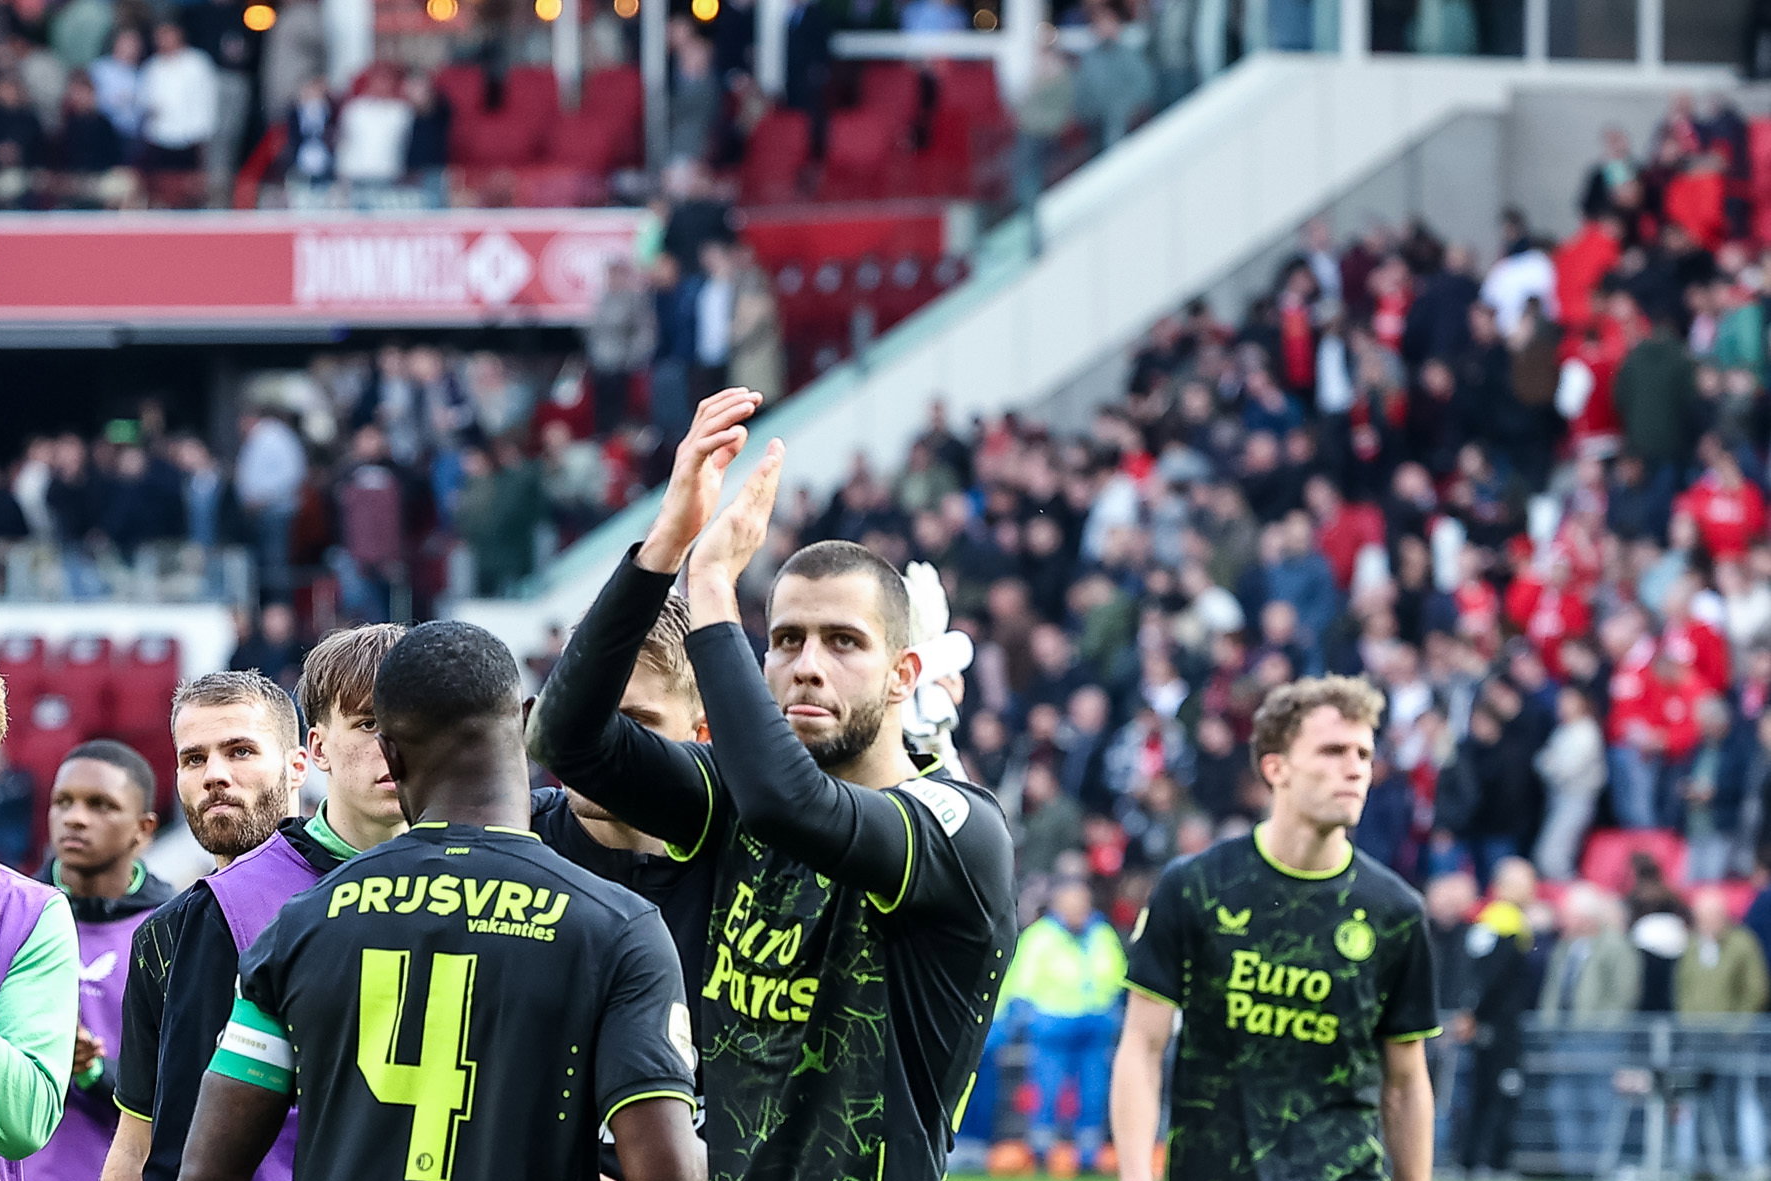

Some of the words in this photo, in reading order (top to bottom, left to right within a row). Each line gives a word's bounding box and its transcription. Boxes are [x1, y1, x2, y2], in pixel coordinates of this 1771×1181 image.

[467, 917, 556, 942] vakanties
[724, 881, 803, 966] Euro
[701, 943, 819, 1022] Parcs
[1228, 950, 1332, 1002] Euro
[1226, 992, 1339, 1044] Parcs
